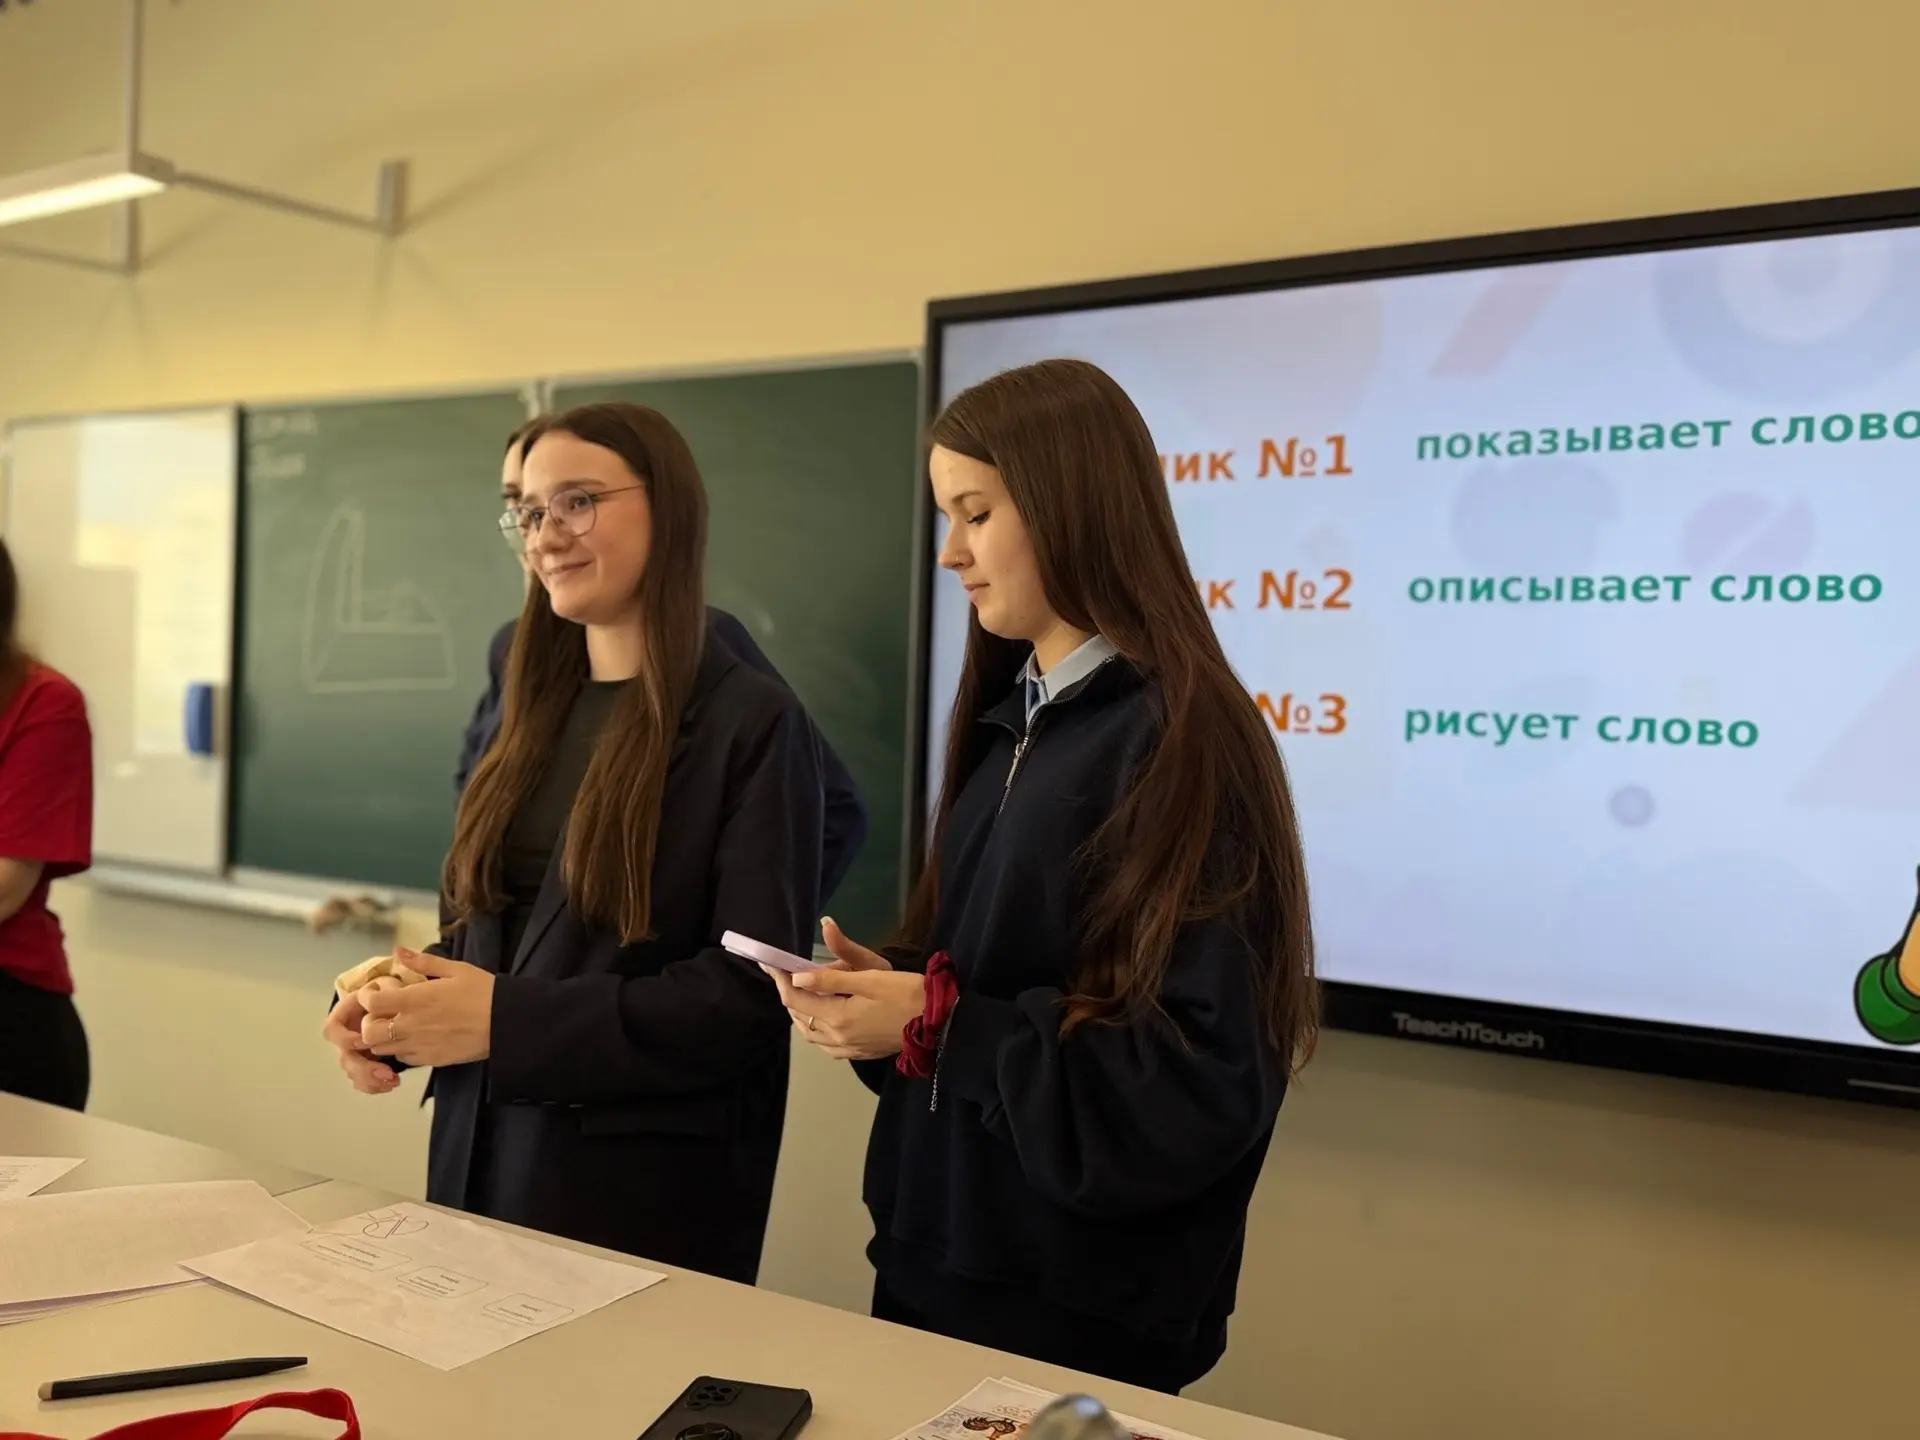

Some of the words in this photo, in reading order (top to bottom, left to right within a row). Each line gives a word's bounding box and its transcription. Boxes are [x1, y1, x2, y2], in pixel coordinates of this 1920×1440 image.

[1257, 433, 1353, 479] №1
[1416, 419, 1732, 461] показывает
[1751, 409, 1920, 446] слово
[1257, 568, 1353, 610] №2
[1407, 574, 1692, 604] описывает
[1710, 572, 1883, 603] слово
[1404, 708, 1580, 747] рисует
[1596, 714, 1760, 748] слово
